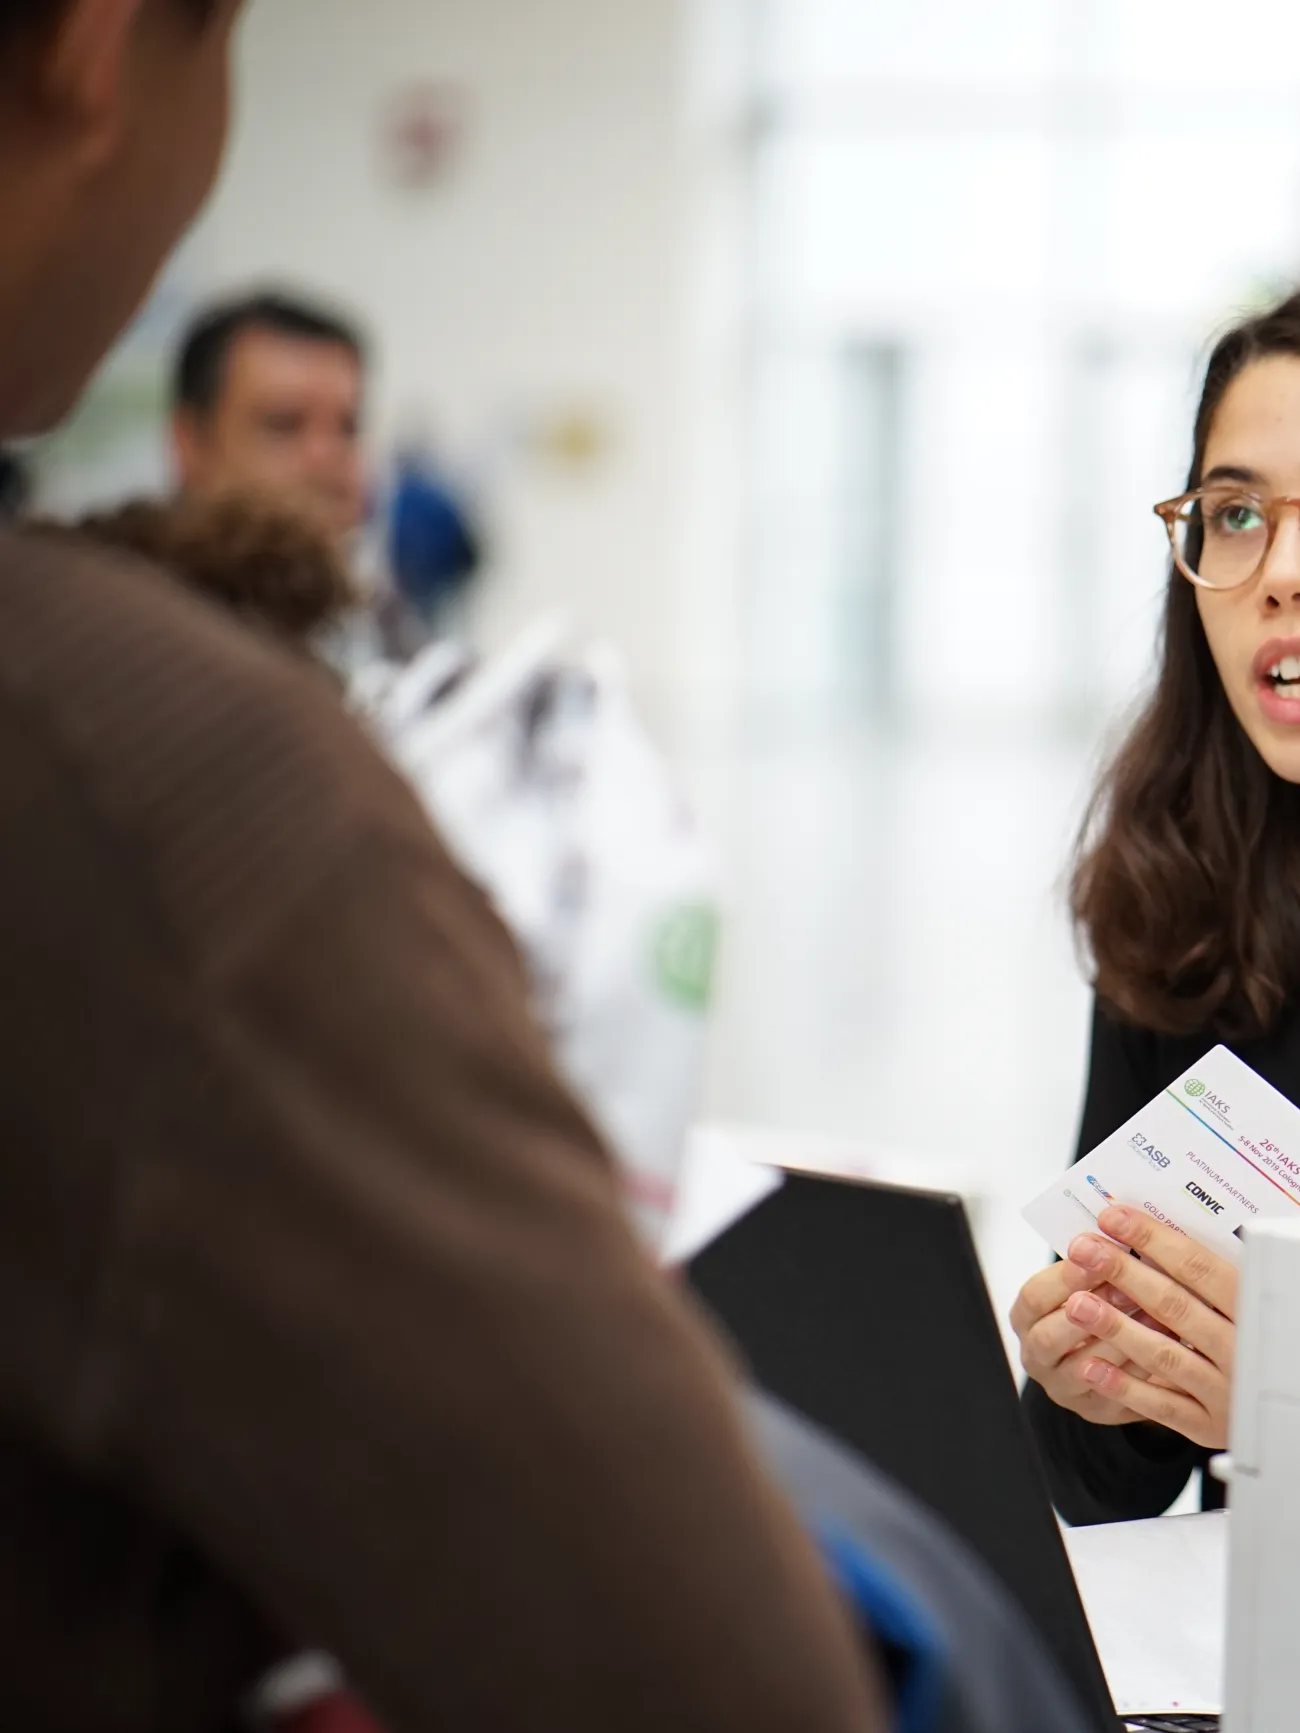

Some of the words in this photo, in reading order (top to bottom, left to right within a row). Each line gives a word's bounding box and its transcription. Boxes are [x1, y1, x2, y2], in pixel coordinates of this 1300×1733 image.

[1205, 1091, 1230, 1113] IAKS
[1142, 1145, 1170, 1168] ASB
[1238, 1136, 1250, 1147] 5-8
[1249, 1145, 1263, 1158] Nov
[1262, 1156, 1280, 1171] 2019
[1260, 1139, 1279, 1154] 26th
[1186, 1151, 1224, 1184] PLATINUM
[1222, 1182, 1259, 1214] PARTNERS
[1185, 1181, 1224, 1215] CONVIC
[1144, 1201, 1165, 1220] GOLD
